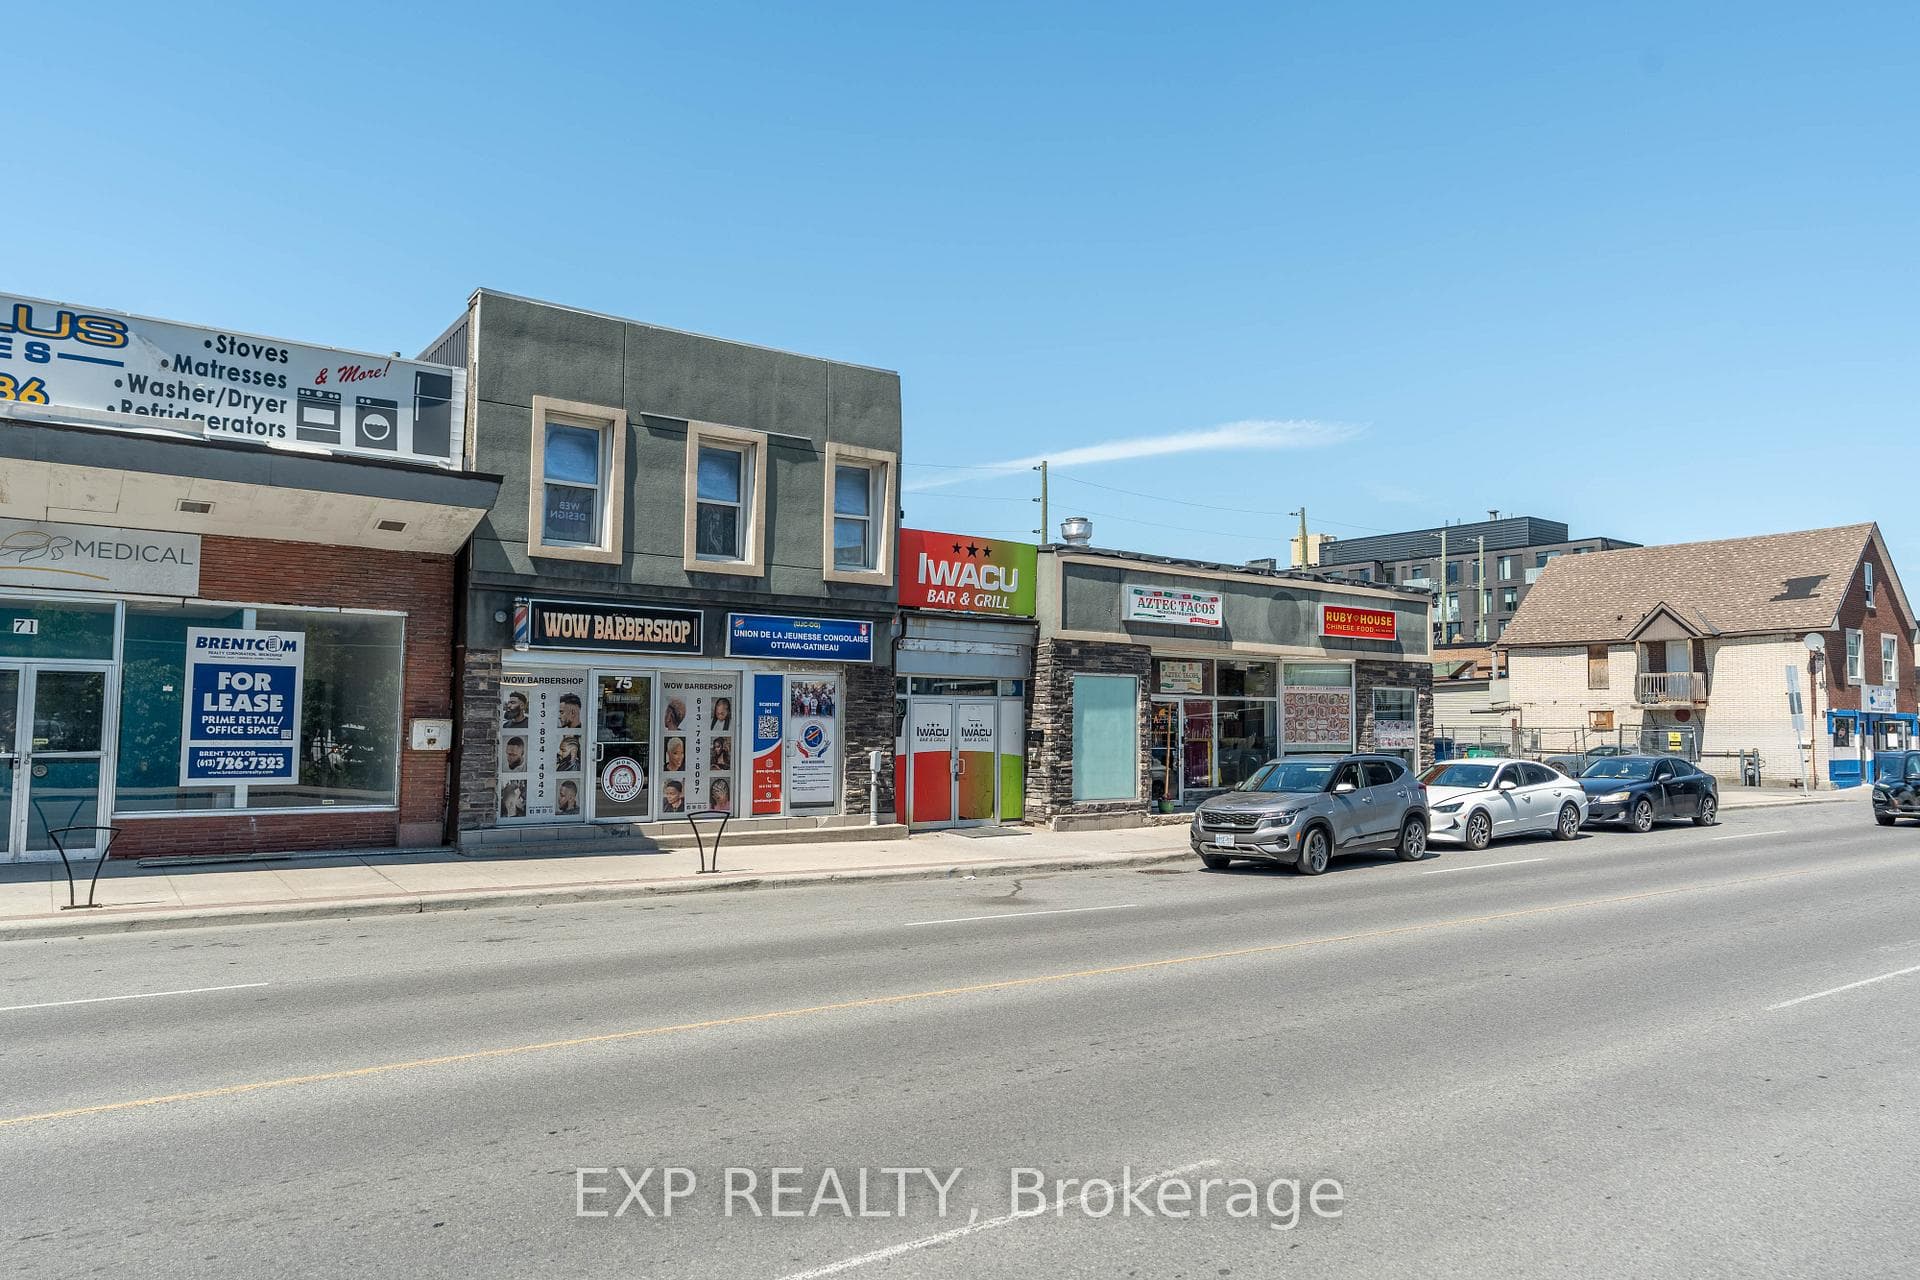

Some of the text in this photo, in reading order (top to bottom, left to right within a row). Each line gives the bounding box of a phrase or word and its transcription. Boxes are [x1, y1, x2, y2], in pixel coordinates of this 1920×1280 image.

[0, 304, 129, 348] US
[215, 334, 289, 364] Stoves
[172, 353, 288, 389] Matresses
[315, 360, 392, 385] & More!
[127, 373, 288, 414] Washer/Dryer
[74, 539, 194, 566] MEDICAL
[917, 552, 1019, 593] IWACU
[927, 589, 1010, 609] BAR & GRILL
[1137, 597, 1217, 615] AZTEC TACOS
[14, 619, 35, 633] 71
[543, 611, 692, 644] WOW BARBERSHOP
[1326, 611, 1393, 627] RUBY HOUSE
[733, 629, 869, 643] UNION DE LA JEUNESSE CONGOLAISE
[1326, 623, 1355, 632] CHINESE
[1356, 625, 1375, 633] FOOD
[770, 641, 839, 652] OTTAWA-GATINEAU
[218, 671, 272, 691] FOR
[502, 676, 584, 685] WOW BARBERSHOP
[614, 676, 633, 689] 75
[663, 682, 733, 691] WOW BARBERSHOP
[203, 692, 284, 712] LEASE
[202, 715, 236, 724] PRIME
[206, 725, 279, 734] OFFICE SPACE
[916, 726, 950, 737] IWACU
[961, 727, 993, 737] IWACU
